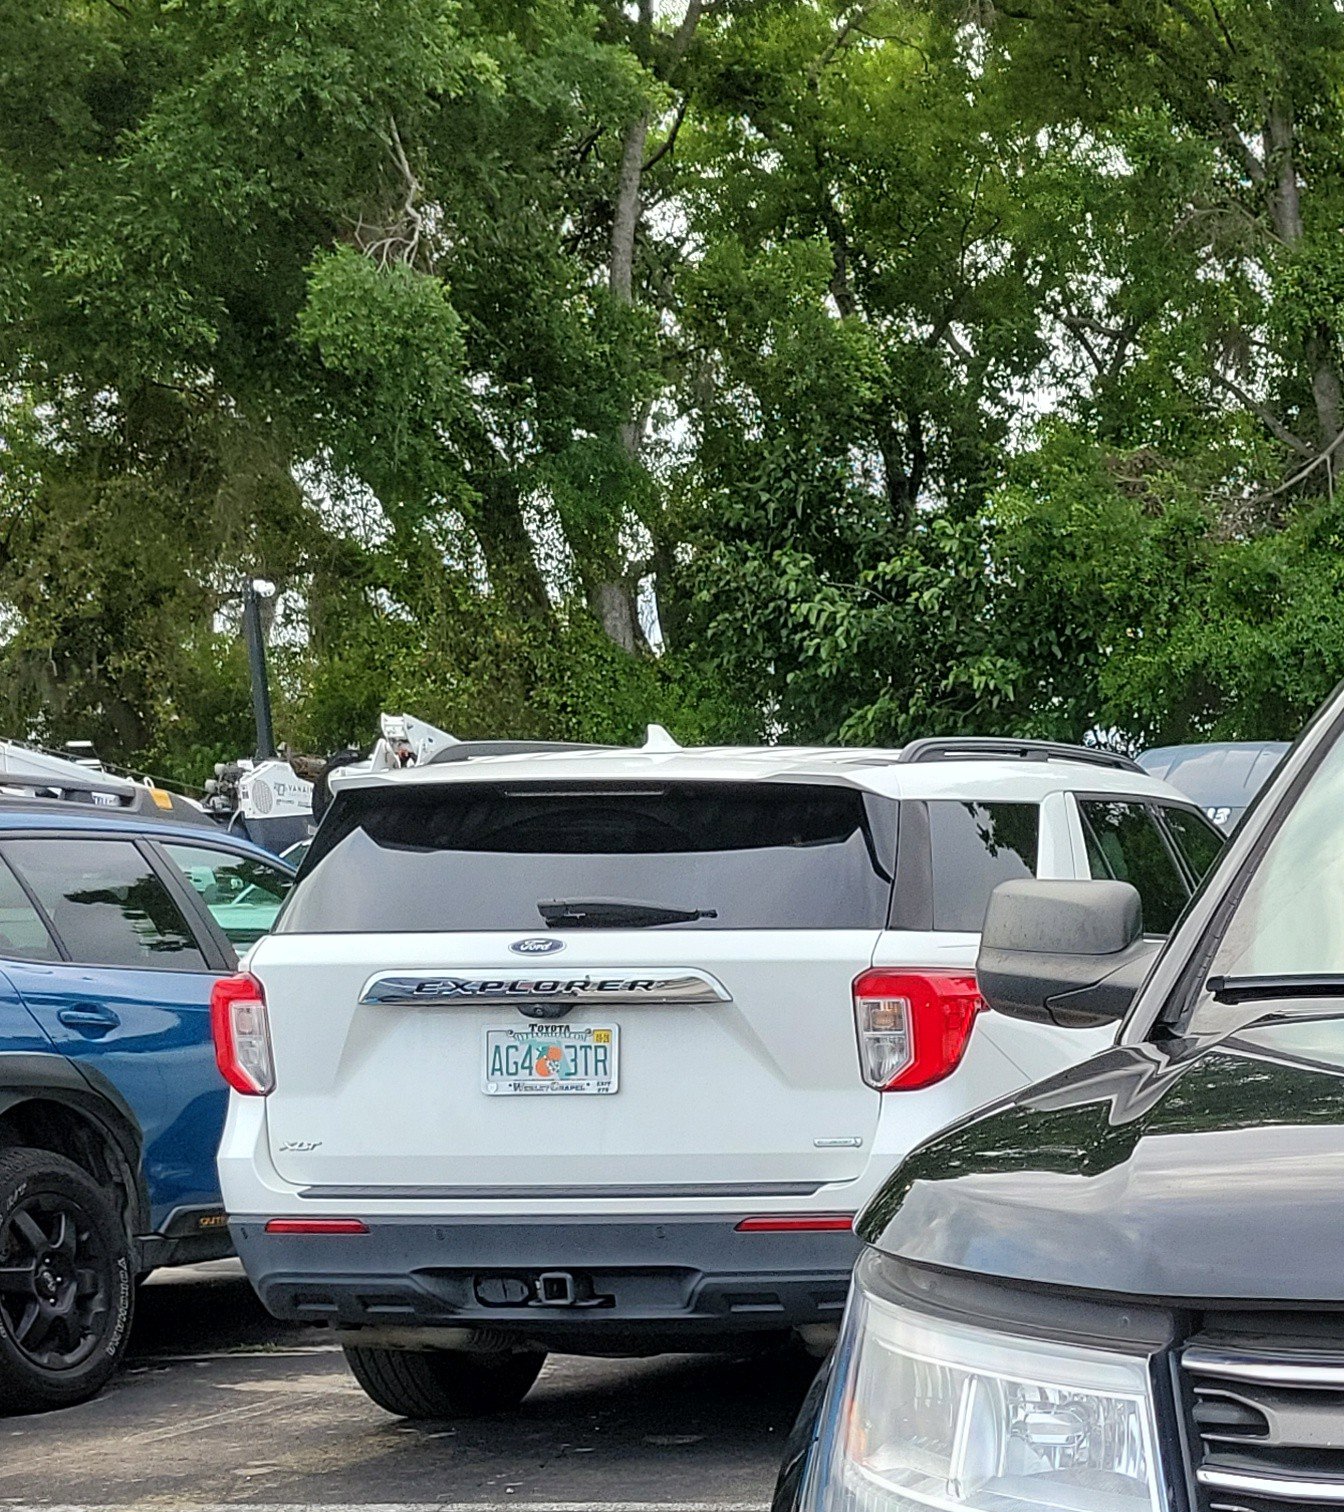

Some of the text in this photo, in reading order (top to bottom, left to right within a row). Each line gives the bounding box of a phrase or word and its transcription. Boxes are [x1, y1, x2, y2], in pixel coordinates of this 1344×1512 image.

[288, 784, 313, 794] VANAI
[520, 939, 553, 951] Ford
[414, 979, 660, 995] EXPLORER
